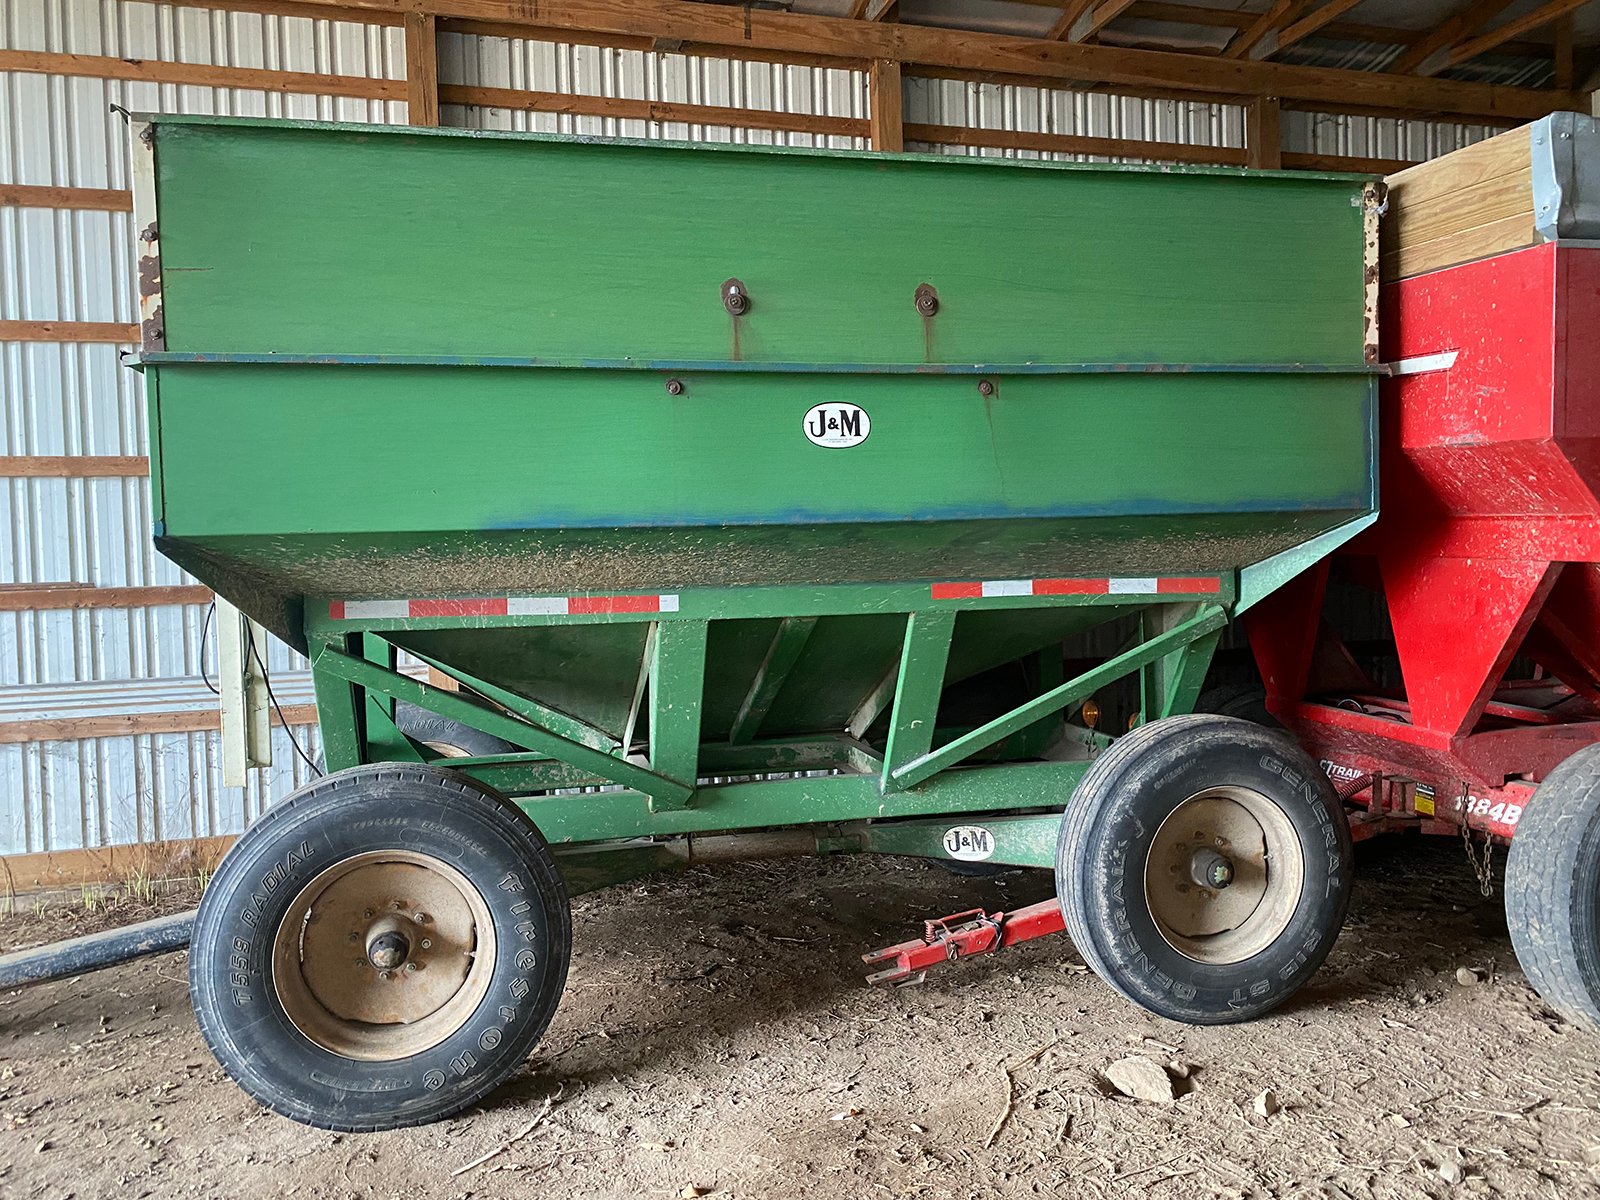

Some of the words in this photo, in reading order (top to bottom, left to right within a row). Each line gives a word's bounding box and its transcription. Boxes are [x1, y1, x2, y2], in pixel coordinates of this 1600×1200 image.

[808, 409, 862, 438] J&M
[398, 719, 456, 733] ADIAL
[1259, 754, 1340, 899] GENERAL
[946, 830, 990, 853] J&M
[241, 840, 316, 929] RADIAL
